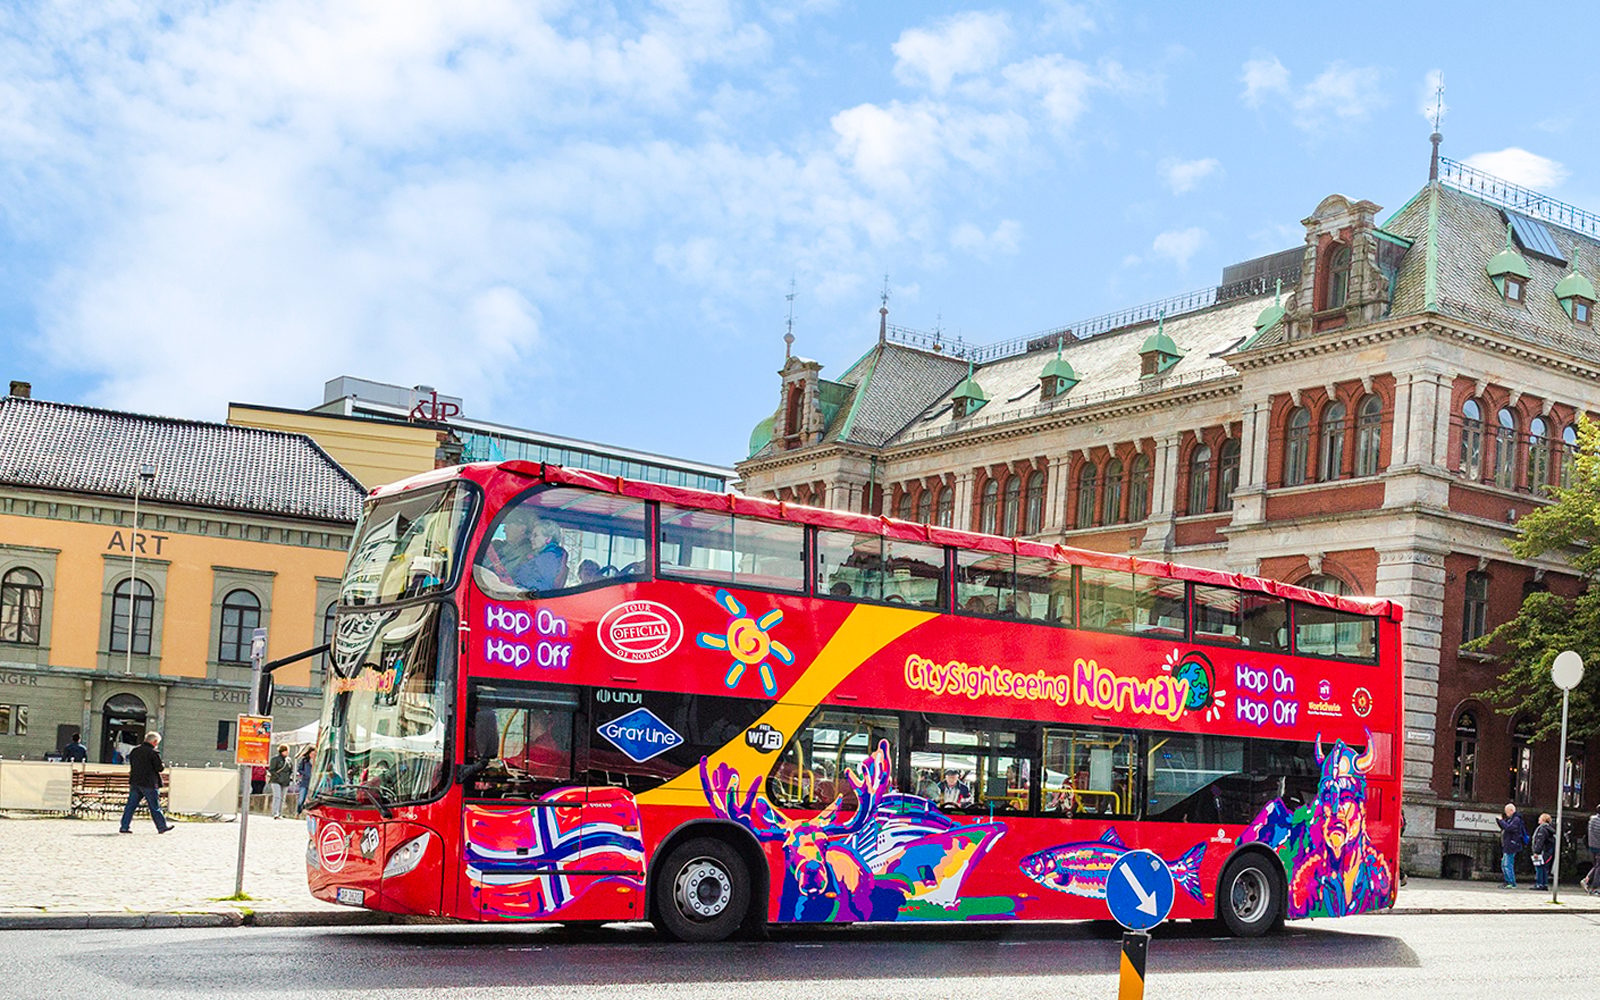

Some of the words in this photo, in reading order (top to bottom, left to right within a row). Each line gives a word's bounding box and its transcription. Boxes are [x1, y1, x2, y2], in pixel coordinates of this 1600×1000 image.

[107, 531, 169, 555] ART
[485, 605, 532, 635] Hop
[536, 609, 568, 635] On
[624, 604, 652, 613] TOUR
[613, 624, 668, 641] OFFICIAL
[485, 638, 532, 668] Hop
[536, 641, 572, 668] Off
[616, 649, 629, 658] OF
[631, 645, 668, 660] NORWAY
[904, 653, 1070, 706] CitySightseeing
[1073, 657, 1190, 722] Norway
[1236, 664, 1269, 694] Hop
[1272, 667, 1295, 693] On
[212, 689, 304, 708] EXHIONS
[1236, 697, 1269, 726] Hop
[1272, 699, 1298, 725] Off
[606, 725, 645, 741] Gray
[645, 727, 676, 745] Line
